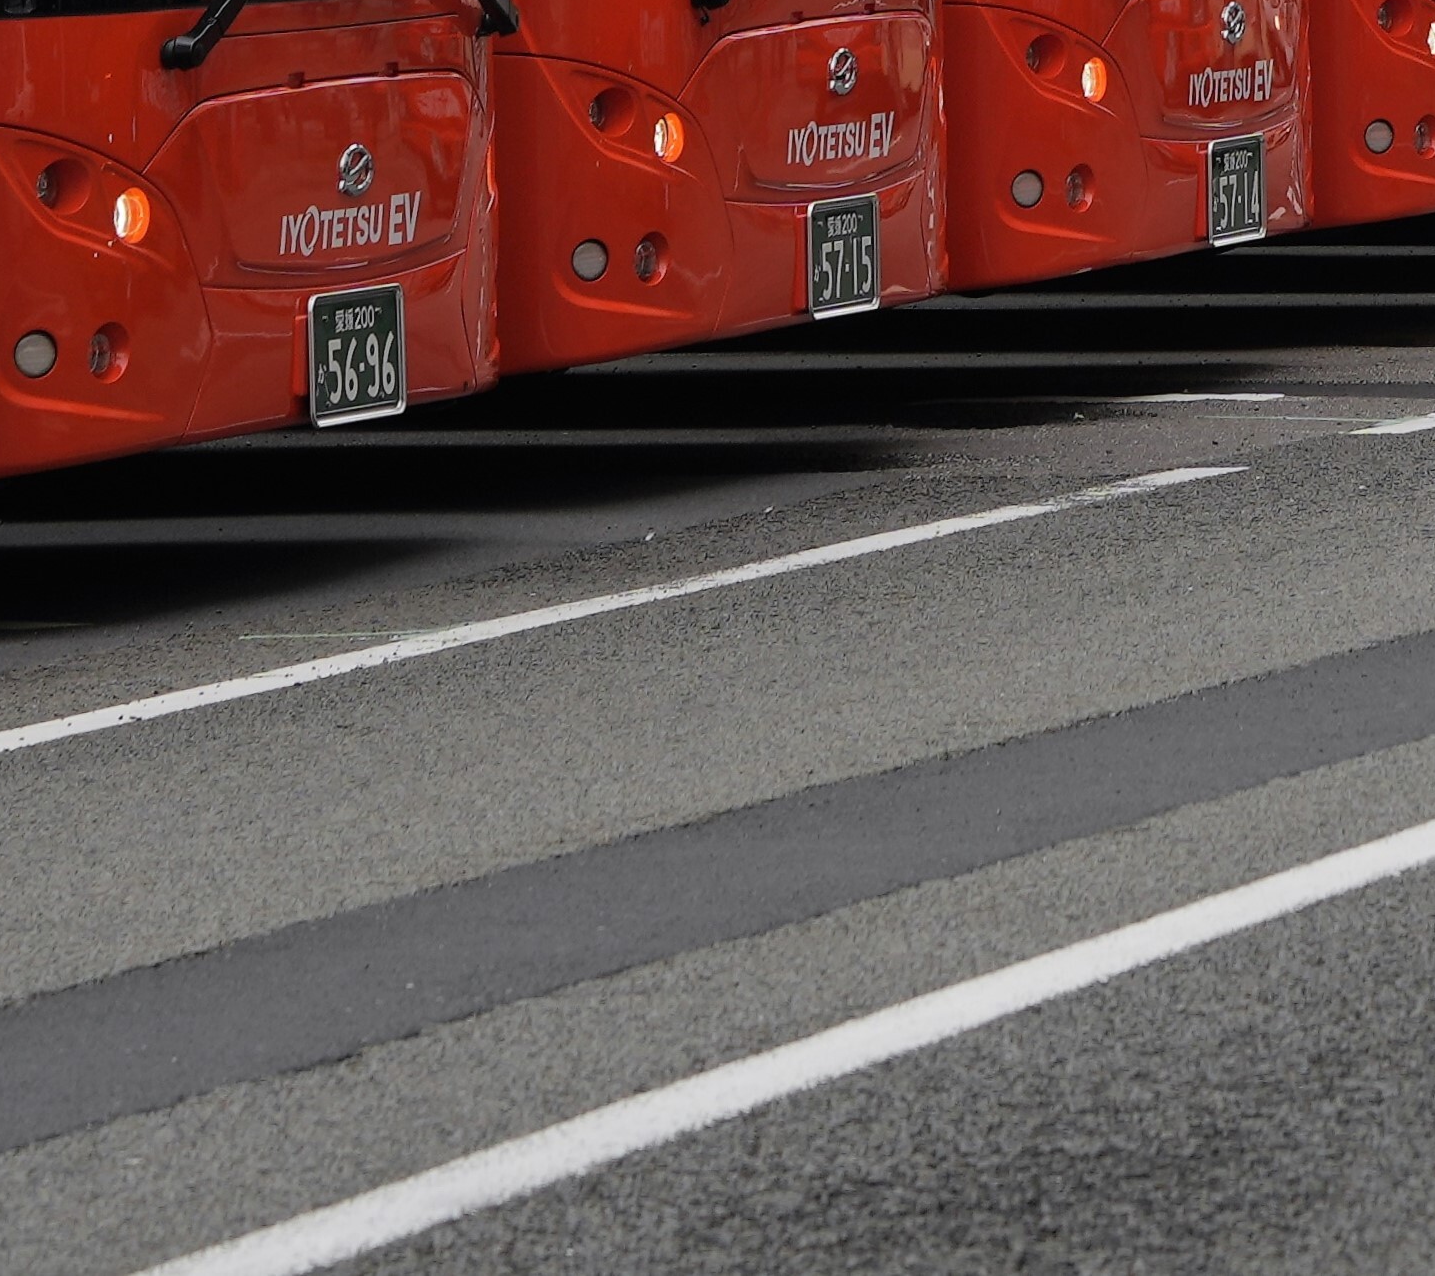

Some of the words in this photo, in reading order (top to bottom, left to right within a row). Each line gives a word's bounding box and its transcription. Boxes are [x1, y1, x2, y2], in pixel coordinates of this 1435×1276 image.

[1189, 67, 1252, 108] IYOTETSU
[1254, 59, 1274, 102] EV
[787, 121, 866, 166] IYOTETSU
[870, 111, 895, 158] EV
[279, 204, 384, 257] IYOTETSU
[388, 191, 421, 246] EV
[1219, 170, 1260, 230] 57-14
[822, 235, 872, 301] 57-15
[328, 330, 395, 405] 56-96
